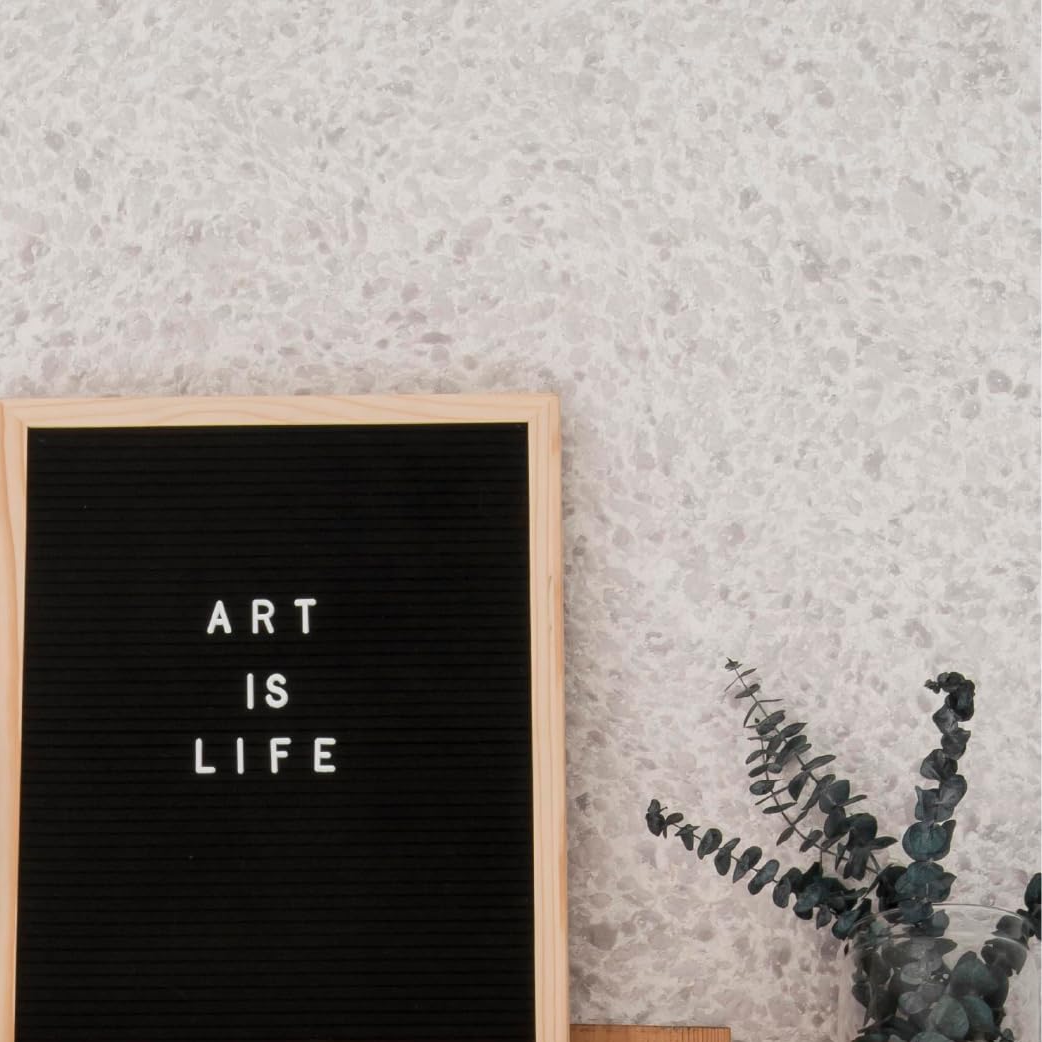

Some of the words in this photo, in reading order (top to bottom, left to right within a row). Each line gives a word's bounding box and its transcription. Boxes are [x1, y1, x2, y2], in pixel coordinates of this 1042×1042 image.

[207, 598, 317, 634] ART
[246, 673, 289, 709] IS
[195, 737, 337, 774] LIFE
